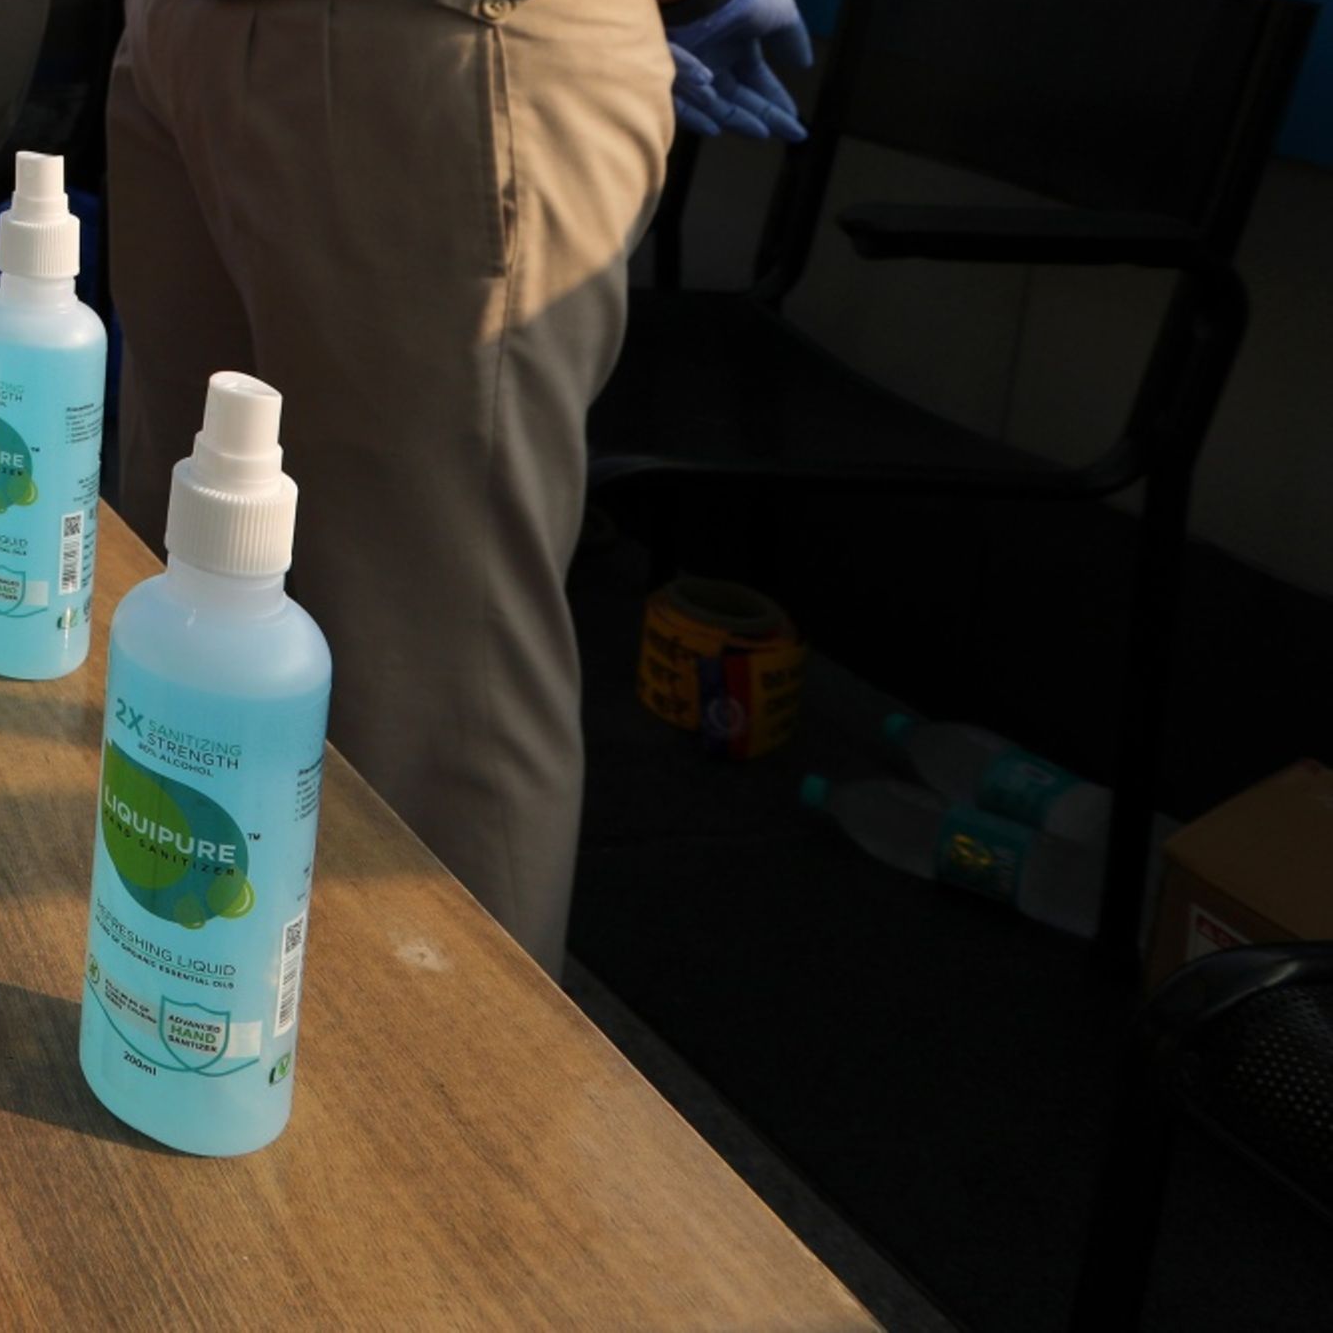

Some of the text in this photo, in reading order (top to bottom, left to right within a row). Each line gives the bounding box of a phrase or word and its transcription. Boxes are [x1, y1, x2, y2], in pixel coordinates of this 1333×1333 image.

[114, 697, 145, 738] 2X
[145, 732, 240, 771] STRENGTH
[147, 719, 243, 758] SANITIZING
[158, 754, 215, 778] ALCOHOL
[103, 784, 237, 865] LIQUIPURE
[138, 838, 235, 877] SANITIZER
[176, 955, 237, 977] LIQUID
[167, 1014, 222, 1034] ADVANCED
[169, 1023, 217, 1045] HAND
[166, 1033, 219, 1054] SANITIZER
[121, 1050, 158, 1077] 200ml
